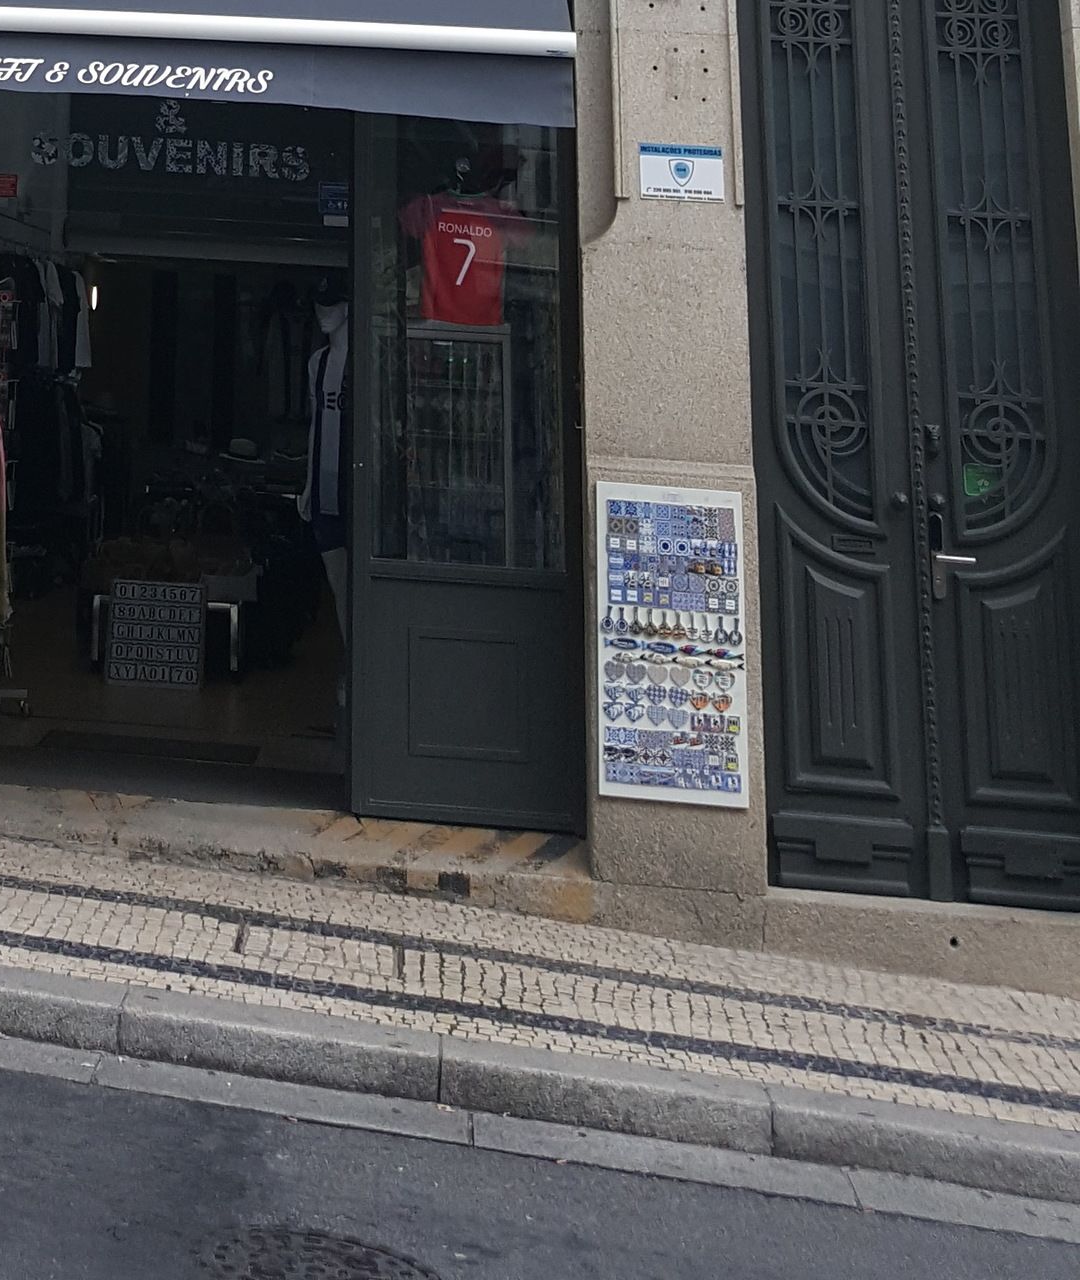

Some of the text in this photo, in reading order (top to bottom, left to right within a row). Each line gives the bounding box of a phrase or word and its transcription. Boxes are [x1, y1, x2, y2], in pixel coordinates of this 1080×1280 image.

[45, 61, 71, 84] &
[76, 61, 275, 94] SOUVENIRS
[30, 130, 312, 183] SOUVENIRS
[437, 221, 493, 238] RONALDO
[453, 237, 477, 287] 7
